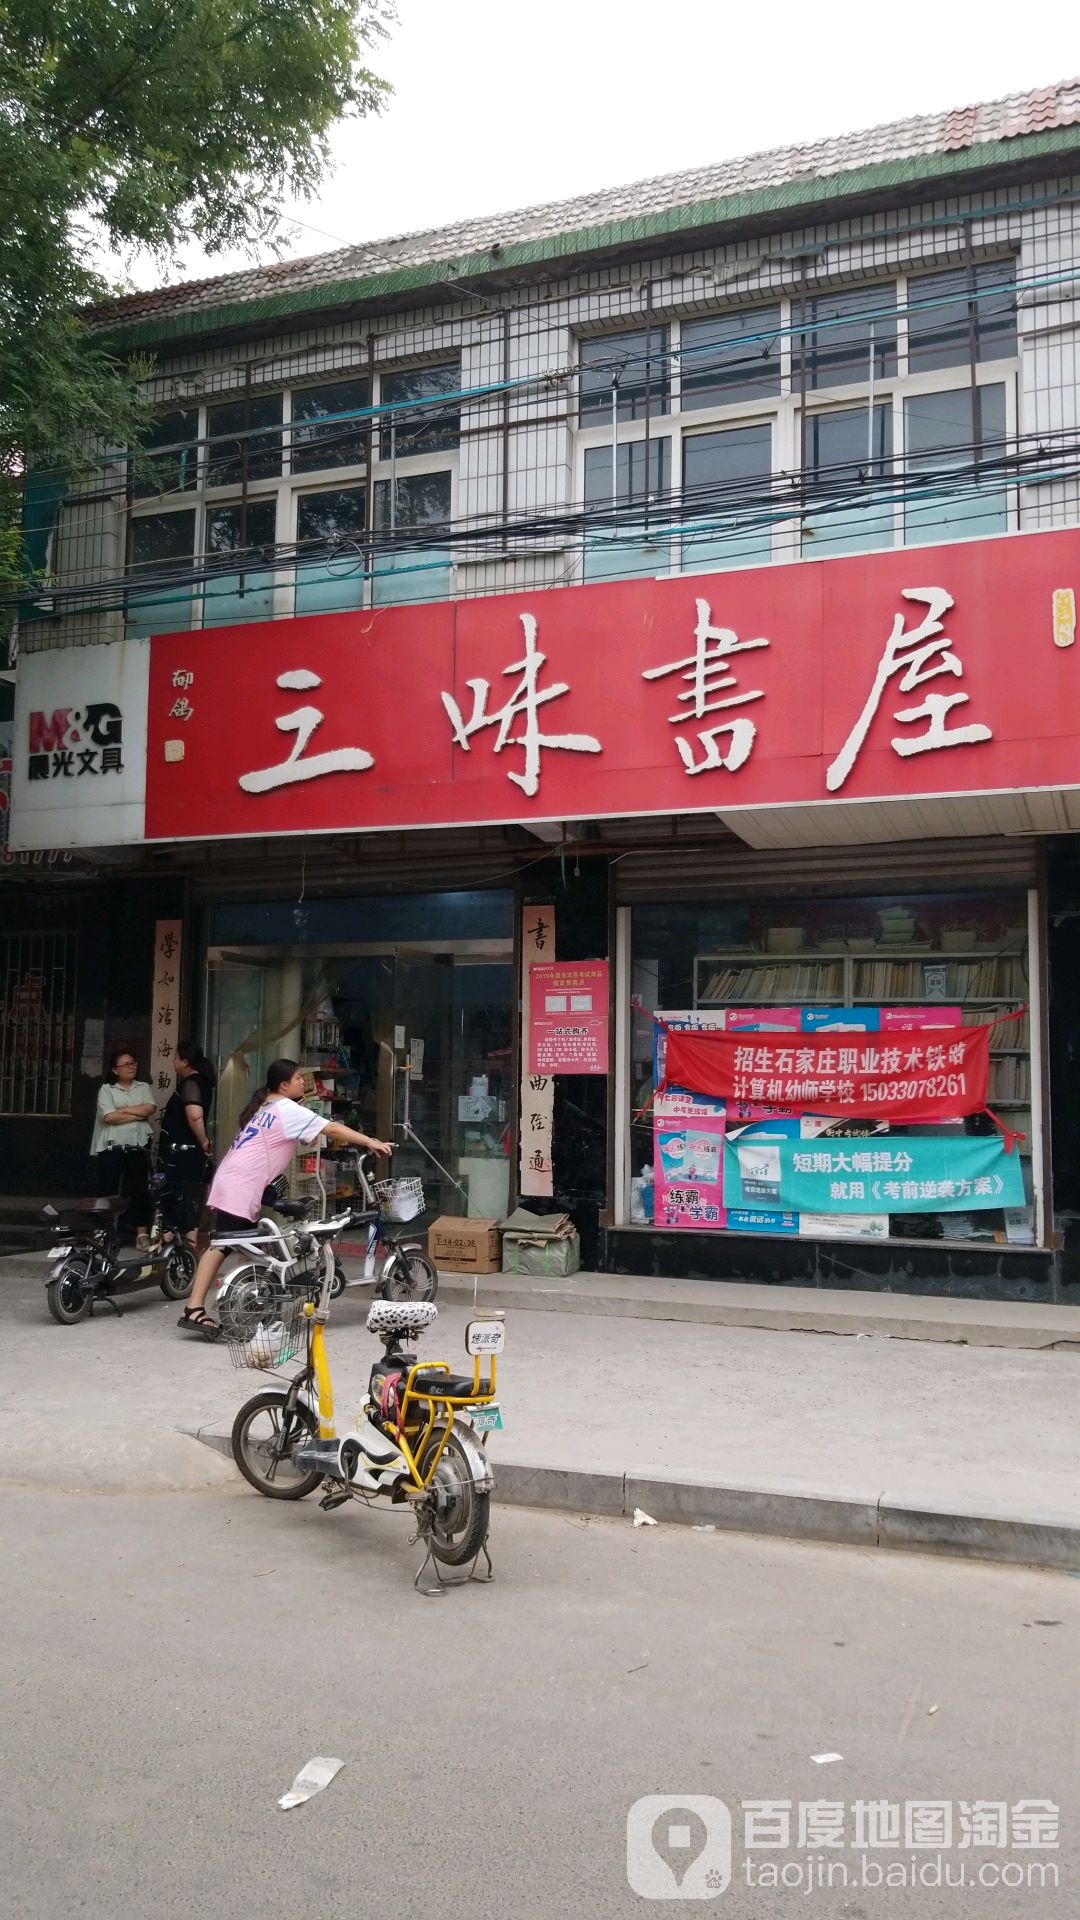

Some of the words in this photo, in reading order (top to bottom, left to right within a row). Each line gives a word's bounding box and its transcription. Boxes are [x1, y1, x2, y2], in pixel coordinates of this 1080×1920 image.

[239, 586, 992, 797] 三味書屋
[28, 702, 123, 753] M&G
[547, 1027, 588, 1035] 一站式购齐
[734, 1041, 967, 1074] 招生石家庄职业技术铁路
[732, 1075, 855, 1104] 计算机幼师学校
[859, 1073, 966, 1103] 15033078261
[793, 1152, 913, 1172] 短期大幅提分
[669, 1189, 700, 1204] 练霸
[830, 1174, 1004, 1200] 就用《考前逆袭方案》
[689, 1205, 719, 1221] 学霸
